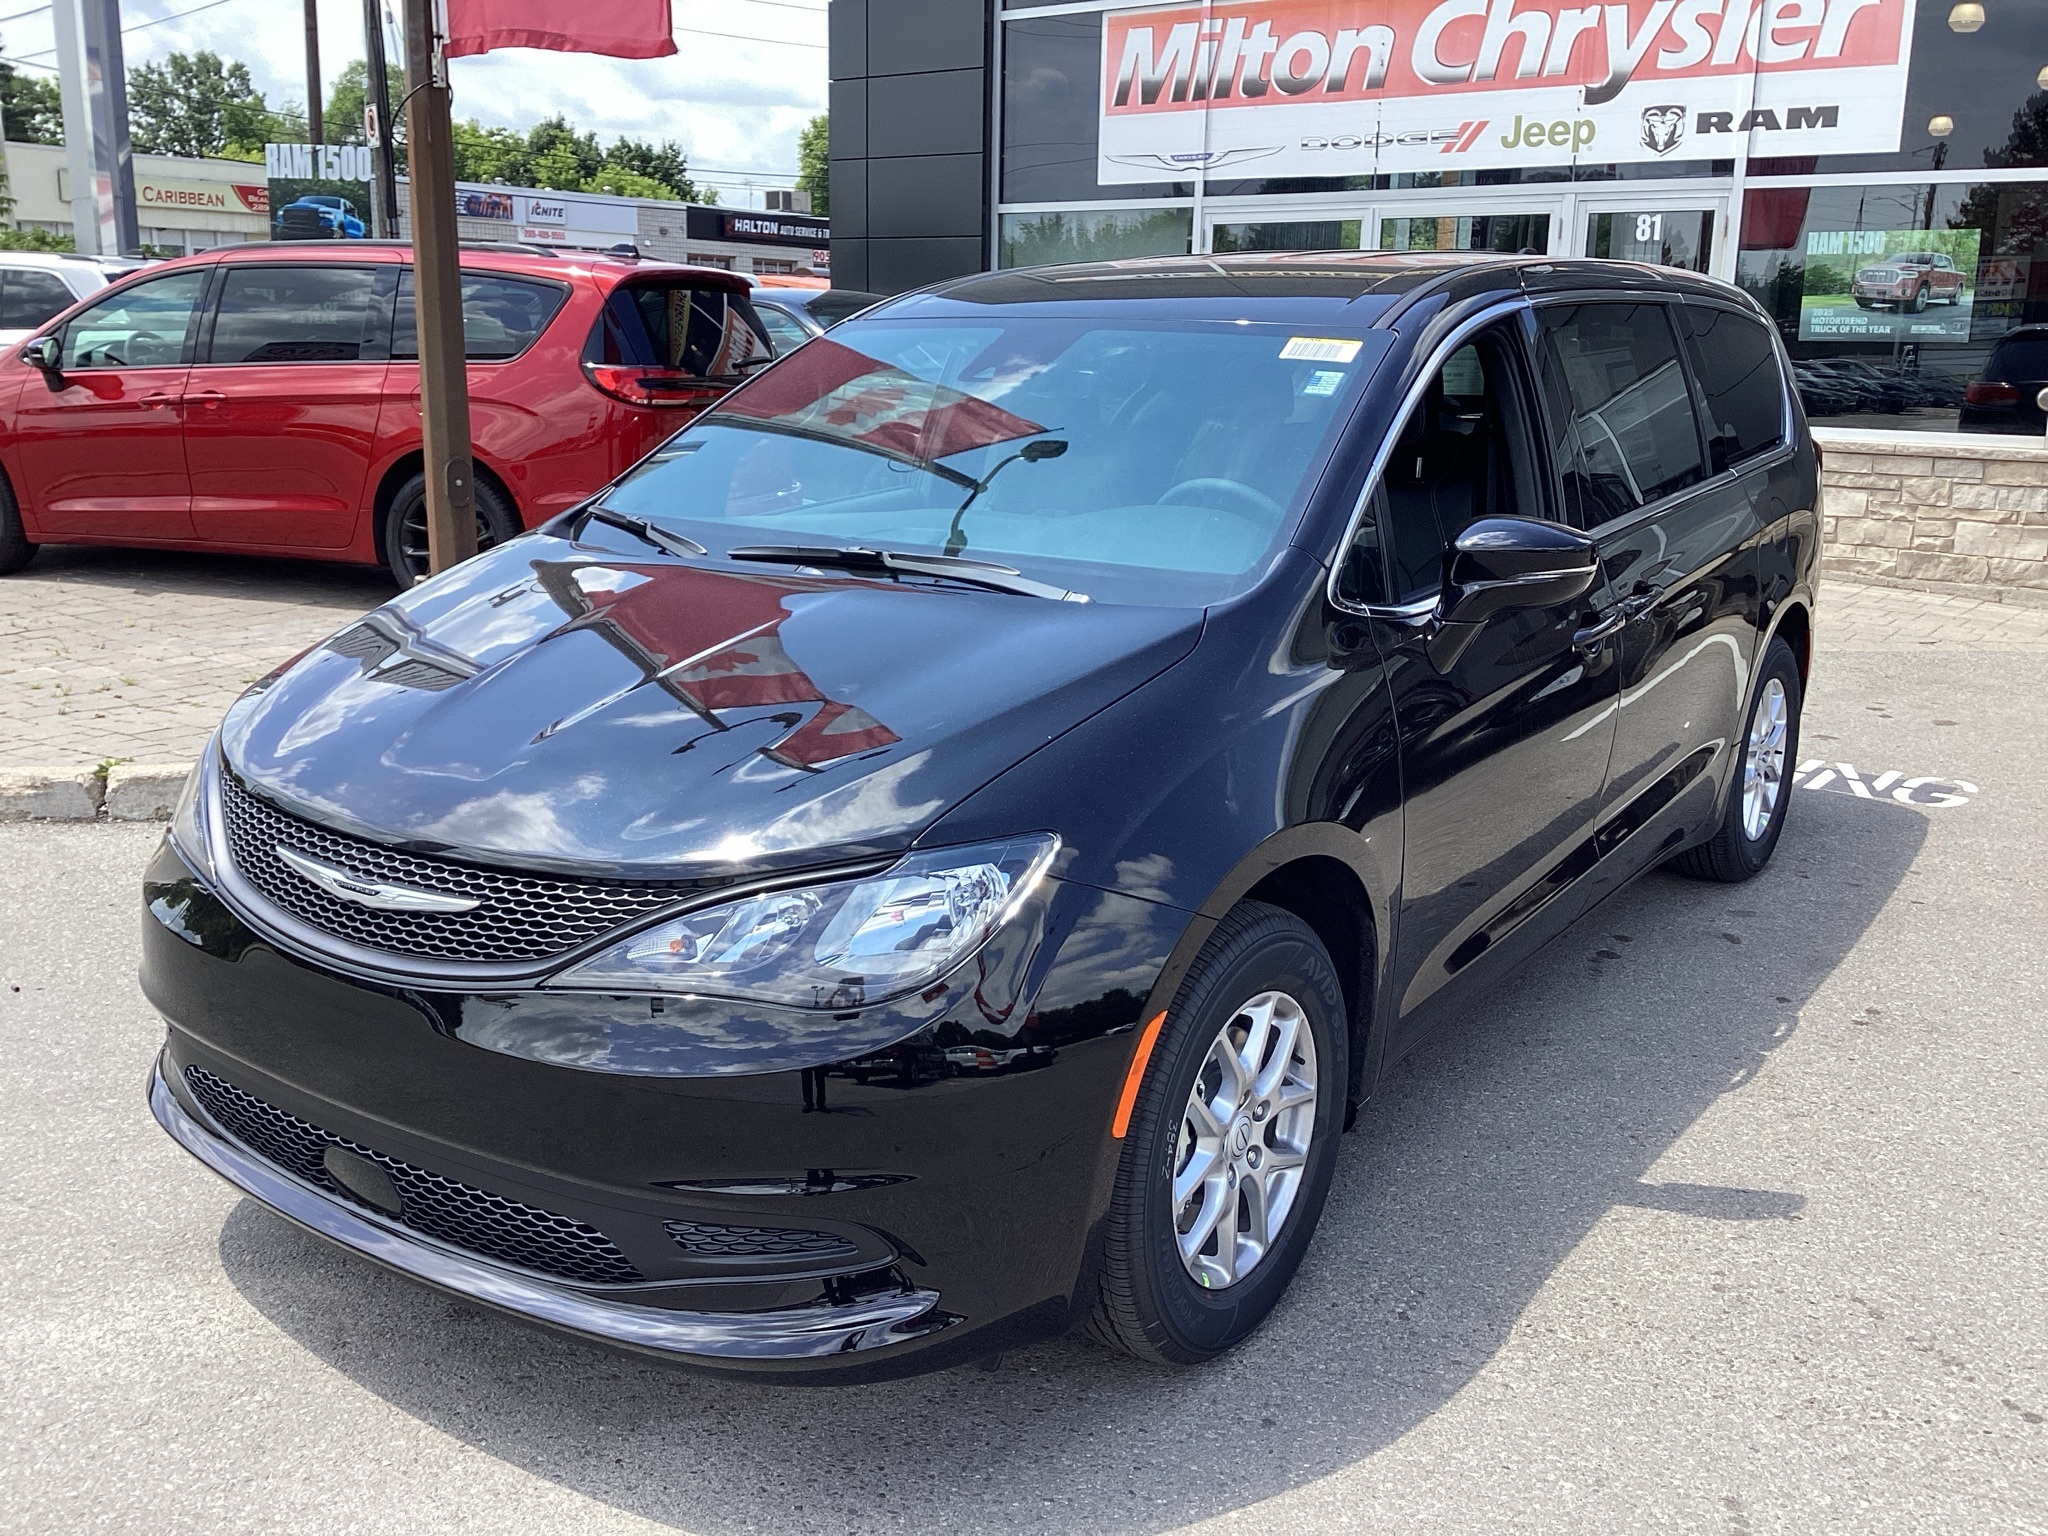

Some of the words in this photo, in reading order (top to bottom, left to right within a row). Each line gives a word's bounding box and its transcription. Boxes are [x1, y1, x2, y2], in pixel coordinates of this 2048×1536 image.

[1113, 17, 1396, 107] Milton
[1411, 0, 1884, 105] Chrysler
[1696, 105, 1840, 134] RAM
[1301, 128, 1461, 151] DODGE
[1500, 115, 1596, 153] Jeep
[266, 144, 313, 179] RAM
[317, 145, 372, 182] 1500
[142, 186, 225, 207] CARIBBEAN
[531, 203, 565, 218] IGNITE
[734, 218, 778, 234] HALTON
[779, 225, 794, 236] AUTO
[795, 226, 817, 238] SERVICE
[1636, 213, 1662, 241] 81
[1806, 232, 1845, 255] RAM
[1846, 231, 1886, 254] 1500
[1811, 316, 1868, 325] MOTORTREND
[1812, 308, 1834, 317] 2025
[1810, 325, 1838, 334] TRUCK
[1839, 325, 1851, 333] OF
[1851, 325, 1867, 334] THE
